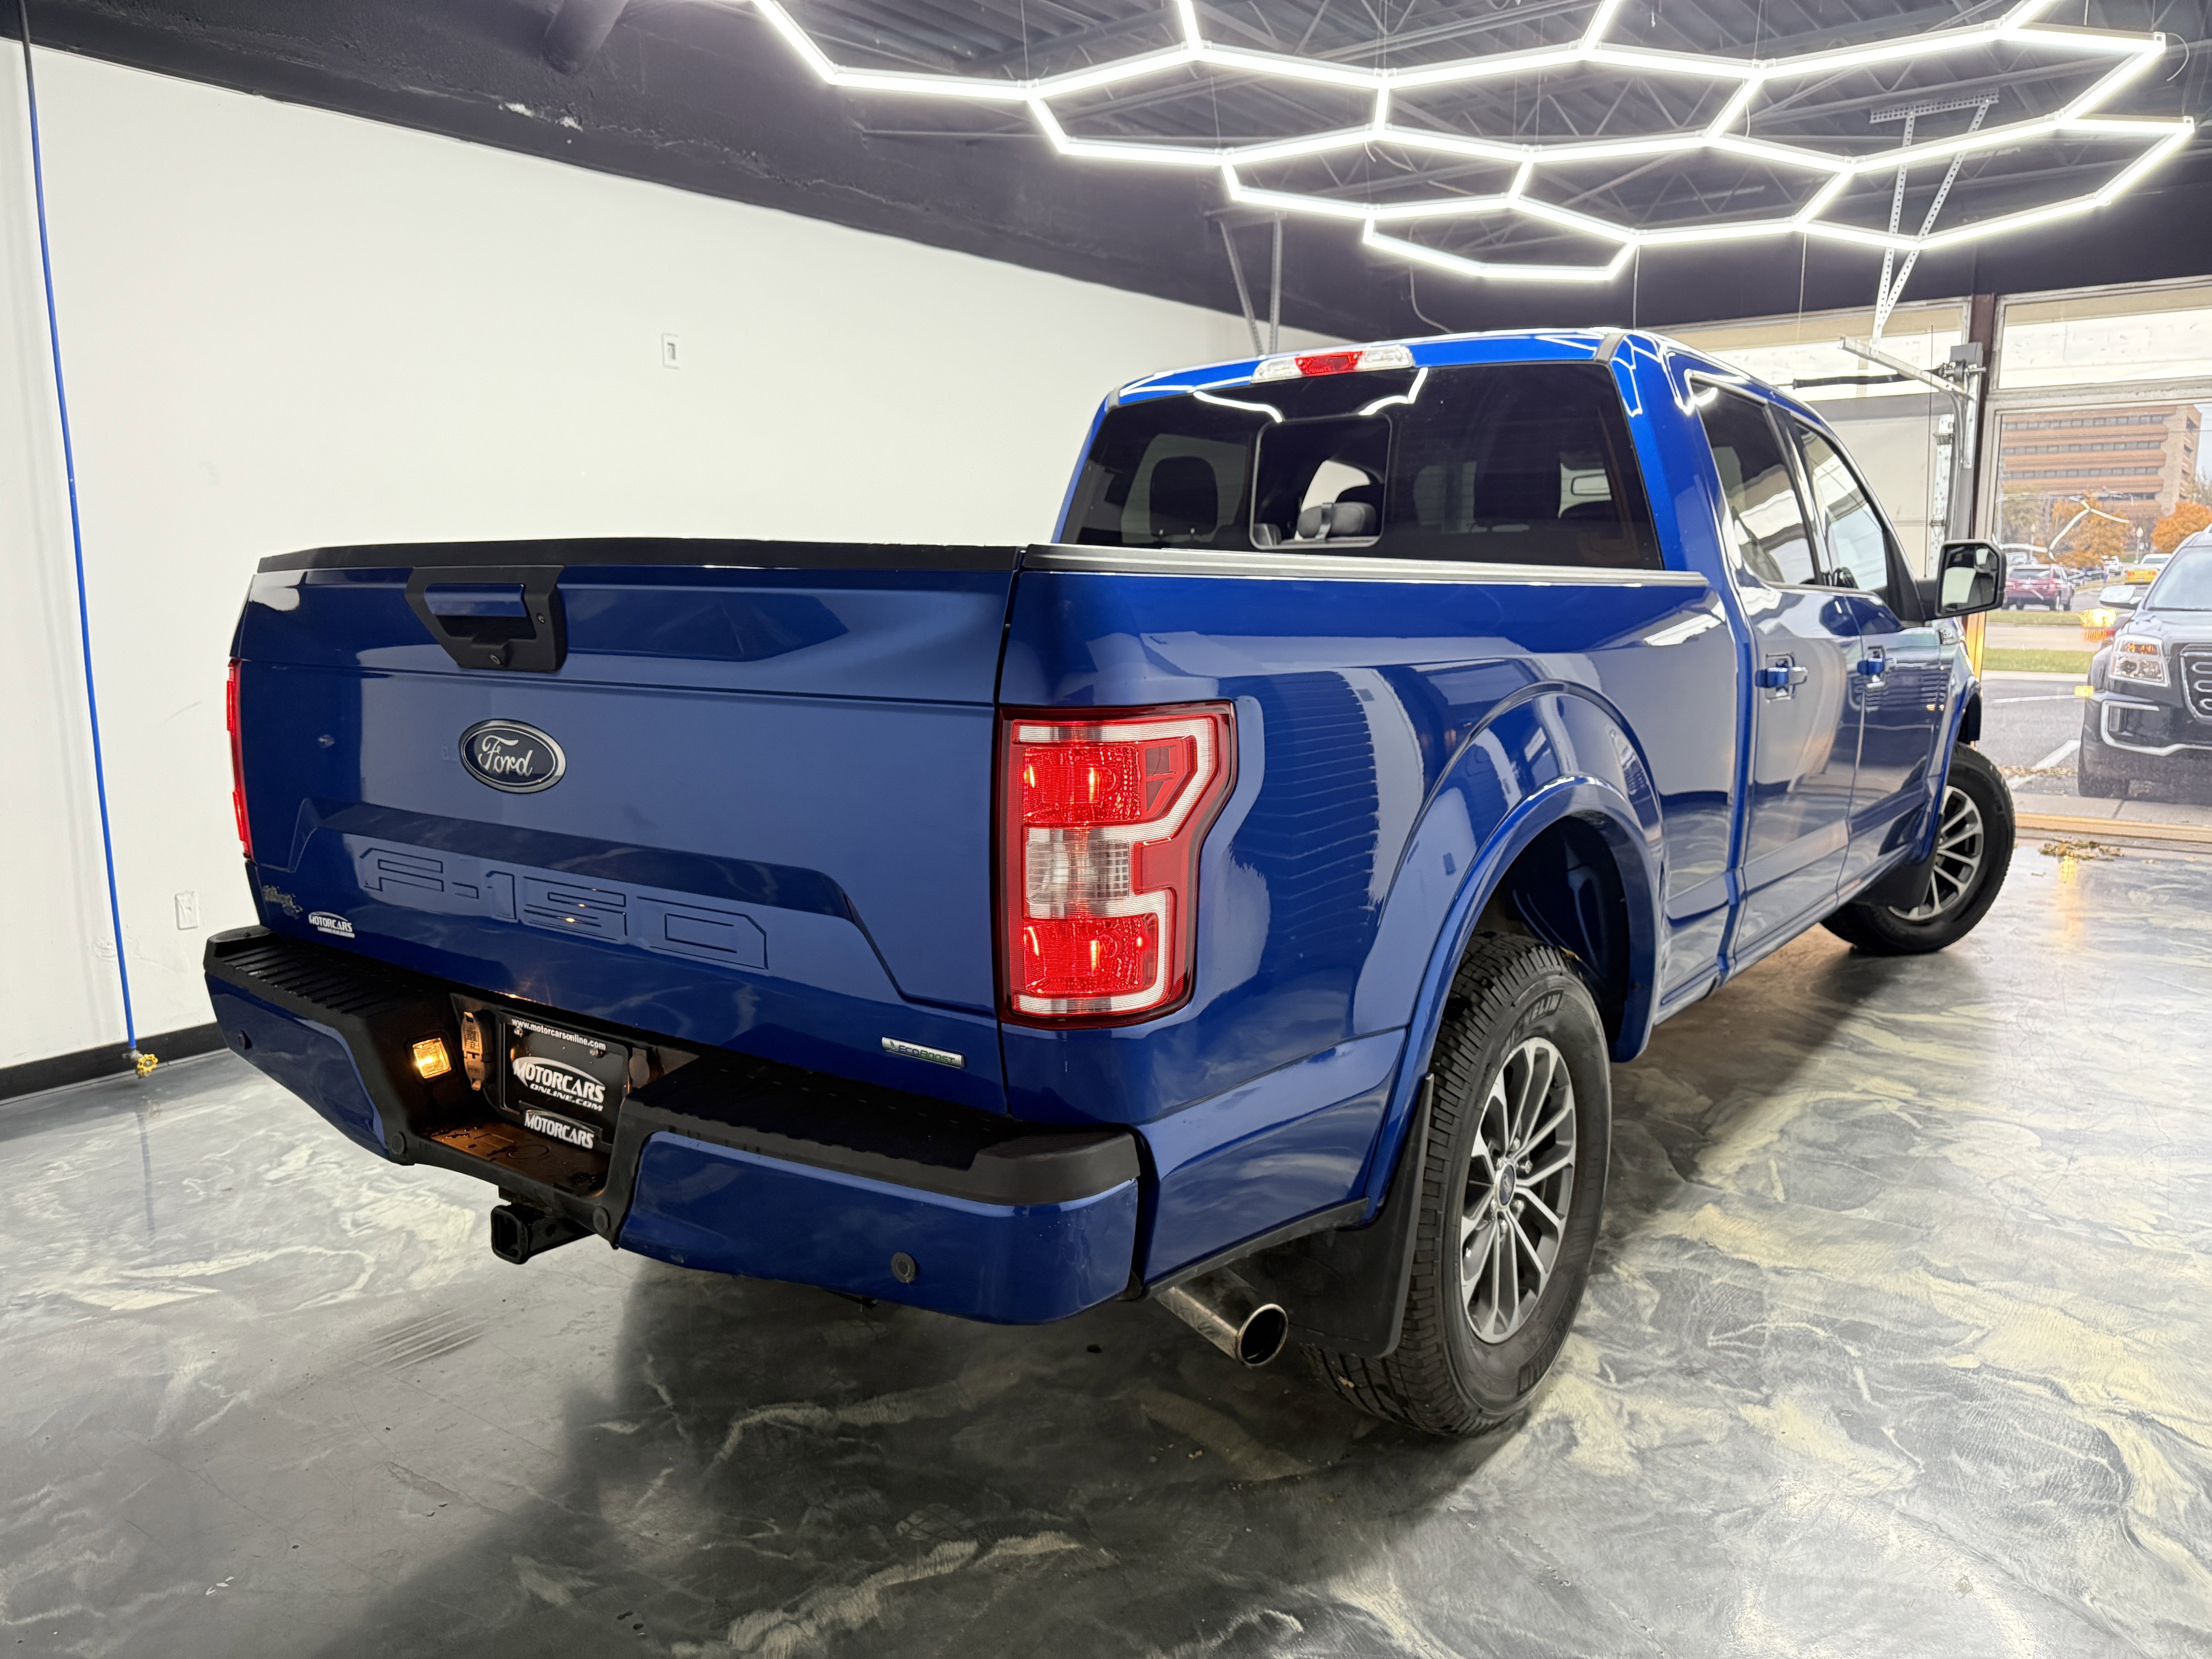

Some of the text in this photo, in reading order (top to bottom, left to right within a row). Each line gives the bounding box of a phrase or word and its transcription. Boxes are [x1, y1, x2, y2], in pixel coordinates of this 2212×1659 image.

[478, 735, 533, 776] Ford
[309, 914, 352, 932] MOTORCARS
[359, 847, 769, 970] F-150
[512, 1018, 606, 1050] www.motorcarsonline.com
[514, 1061, 605, 1103] MOTORCARS
[529, 1084, 603, 1111] ONLINE.COM
[524, 1113, 594, 1149] MOTORCARS
